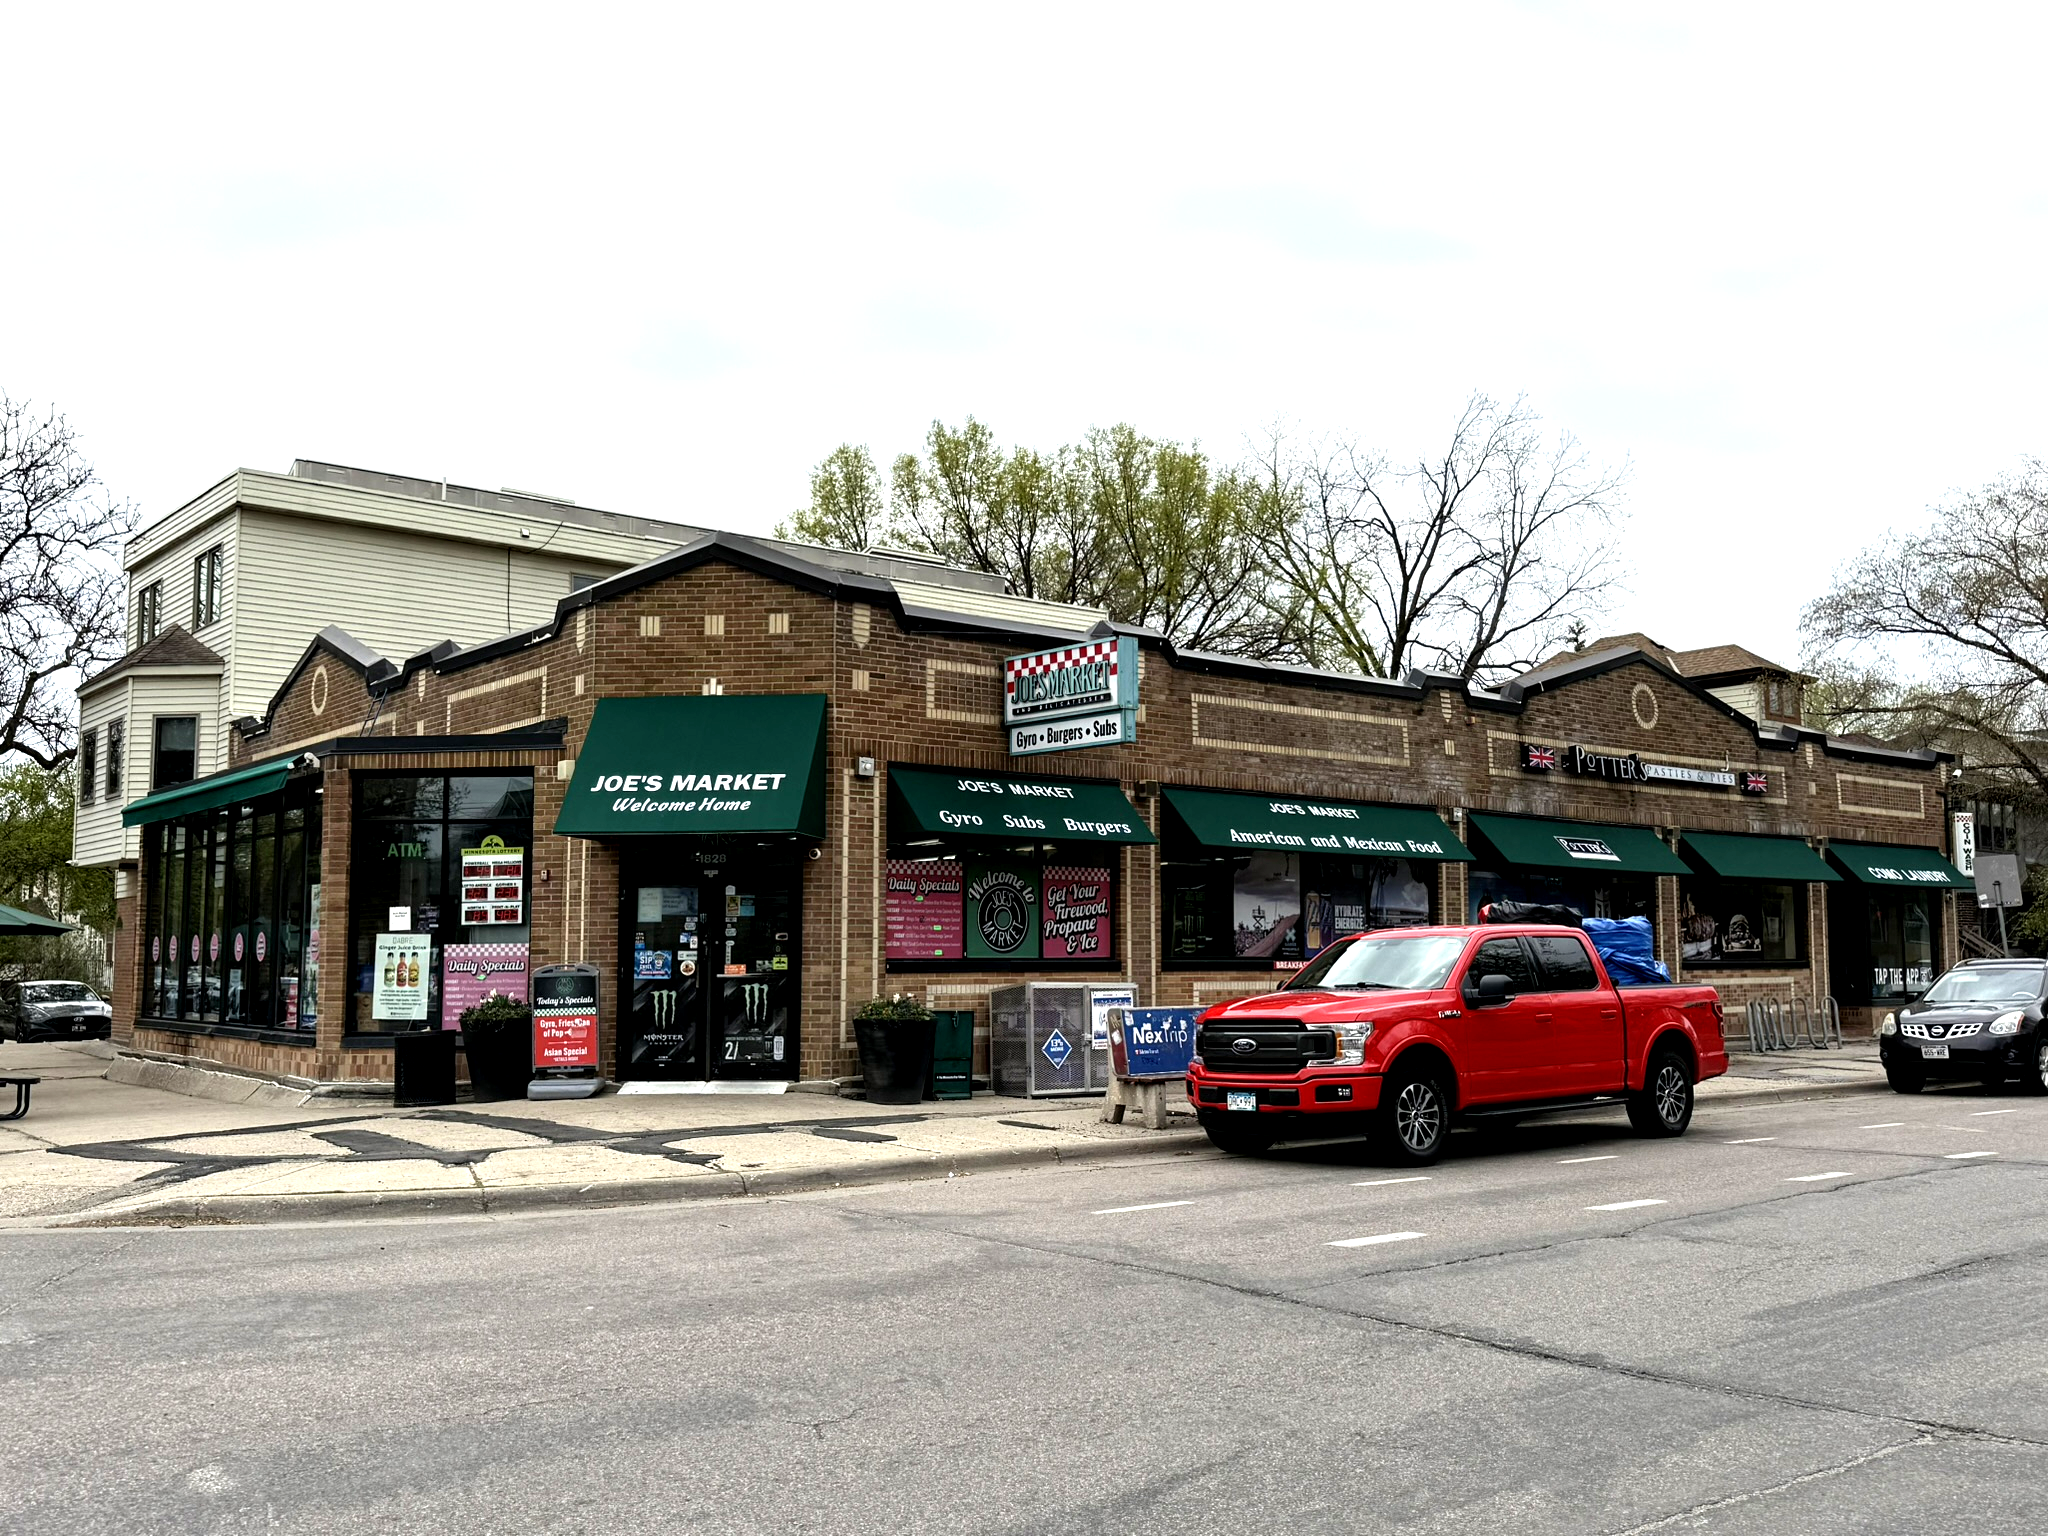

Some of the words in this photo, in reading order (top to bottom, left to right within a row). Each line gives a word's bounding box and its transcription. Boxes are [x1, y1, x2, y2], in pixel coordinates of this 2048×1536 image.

[1047, 661, 1110, 698] MARKET
[1039, 695, 1105, 711] DELICATESSEN
[1016, 731, 1037, 749] Gyro
[1047, 726, 1083, 744] Burgers
[1093, 719, 1117, 737] Subs
[1575, 745, 1648, 781] POTTER'S
[1648, 766, 1692, 780] PASTIES
[1697, 772, 1704, 782] &
[1710, 772, 1734, 784] PIES
[591, 774, 662, 793] JOE'S
[669, 774, 786, 792] MARKET
[957, 779, 1003, 794] JOE'S
[1008, 784, 1075, 799] MARKET
[612, 797, 695, 813] Welcome
[698, 797, 751, 812] Home
[1269, 803, 1306, 815] JOE'S
[1308, 806, 1360, 820] MARKET
[939, 810, 983, 827] Gyro
[1002, 814, 1046, 830] Subs
[1063, 818, 1132, 836] Burgers
[1230, 829, 1305, 847] American
[1311, 835, 1341, 848] and
[1343, 837, 1405, 853] Mexican
[1407, 840, 1443, 855] Food
[1963, 822, 1971, 846] COIN
[387, 843, 422, 857] ATM
[1559, 838, 1613, 854] POTTER'S
[700, 854, 727, 863] 1828
[1964, 848, 1973, 871] WASH
[1868, 866, 1904, 881] COMO
[1901, 869, 1951, 883] LAUNDRY
[887, 877, 917, 894] Daily
[919, 877, 960, 894] Specials
[968, 871, 1025, 900] Welcome
[1022, 886, 1035, 903] to
[991, 890, 1015, 908] JOE'S
[1047, 886, 1068, 907] Get
[1069, 883, 1099, 900] Your
[1054, 898, 1108, 920] Firewood,
[1334, 905, 1365, 918] HYDRATE.
[982, 920, 1024, 947] MARKET
[1043, 918, 1097, 938] Propane
[1066, 935, 1078, 953] &
[1080, 933, 1098, 950] Ice
[447, 959, 478, 975] Daily
[480, 959, 525, 975] Specials
[1874, 967, 1888, 985] TAP
[1889, 967, 1903, 985] THE
[1906, 967, 1919, 985] APP
[536, 996, 564, 1007] Today's
[565, 995, 594, 1006] Specials
[540, 1019, 557, 1029] Gyro,
[543, 1029, 550, 1038] of
[551, 1029, 564, 1038] Pop
[1132, 1022, 1188, 1050] NexTrip
[544, 1047, 563, 1057] Asian
[563, 1047, 588, 1056] Special
